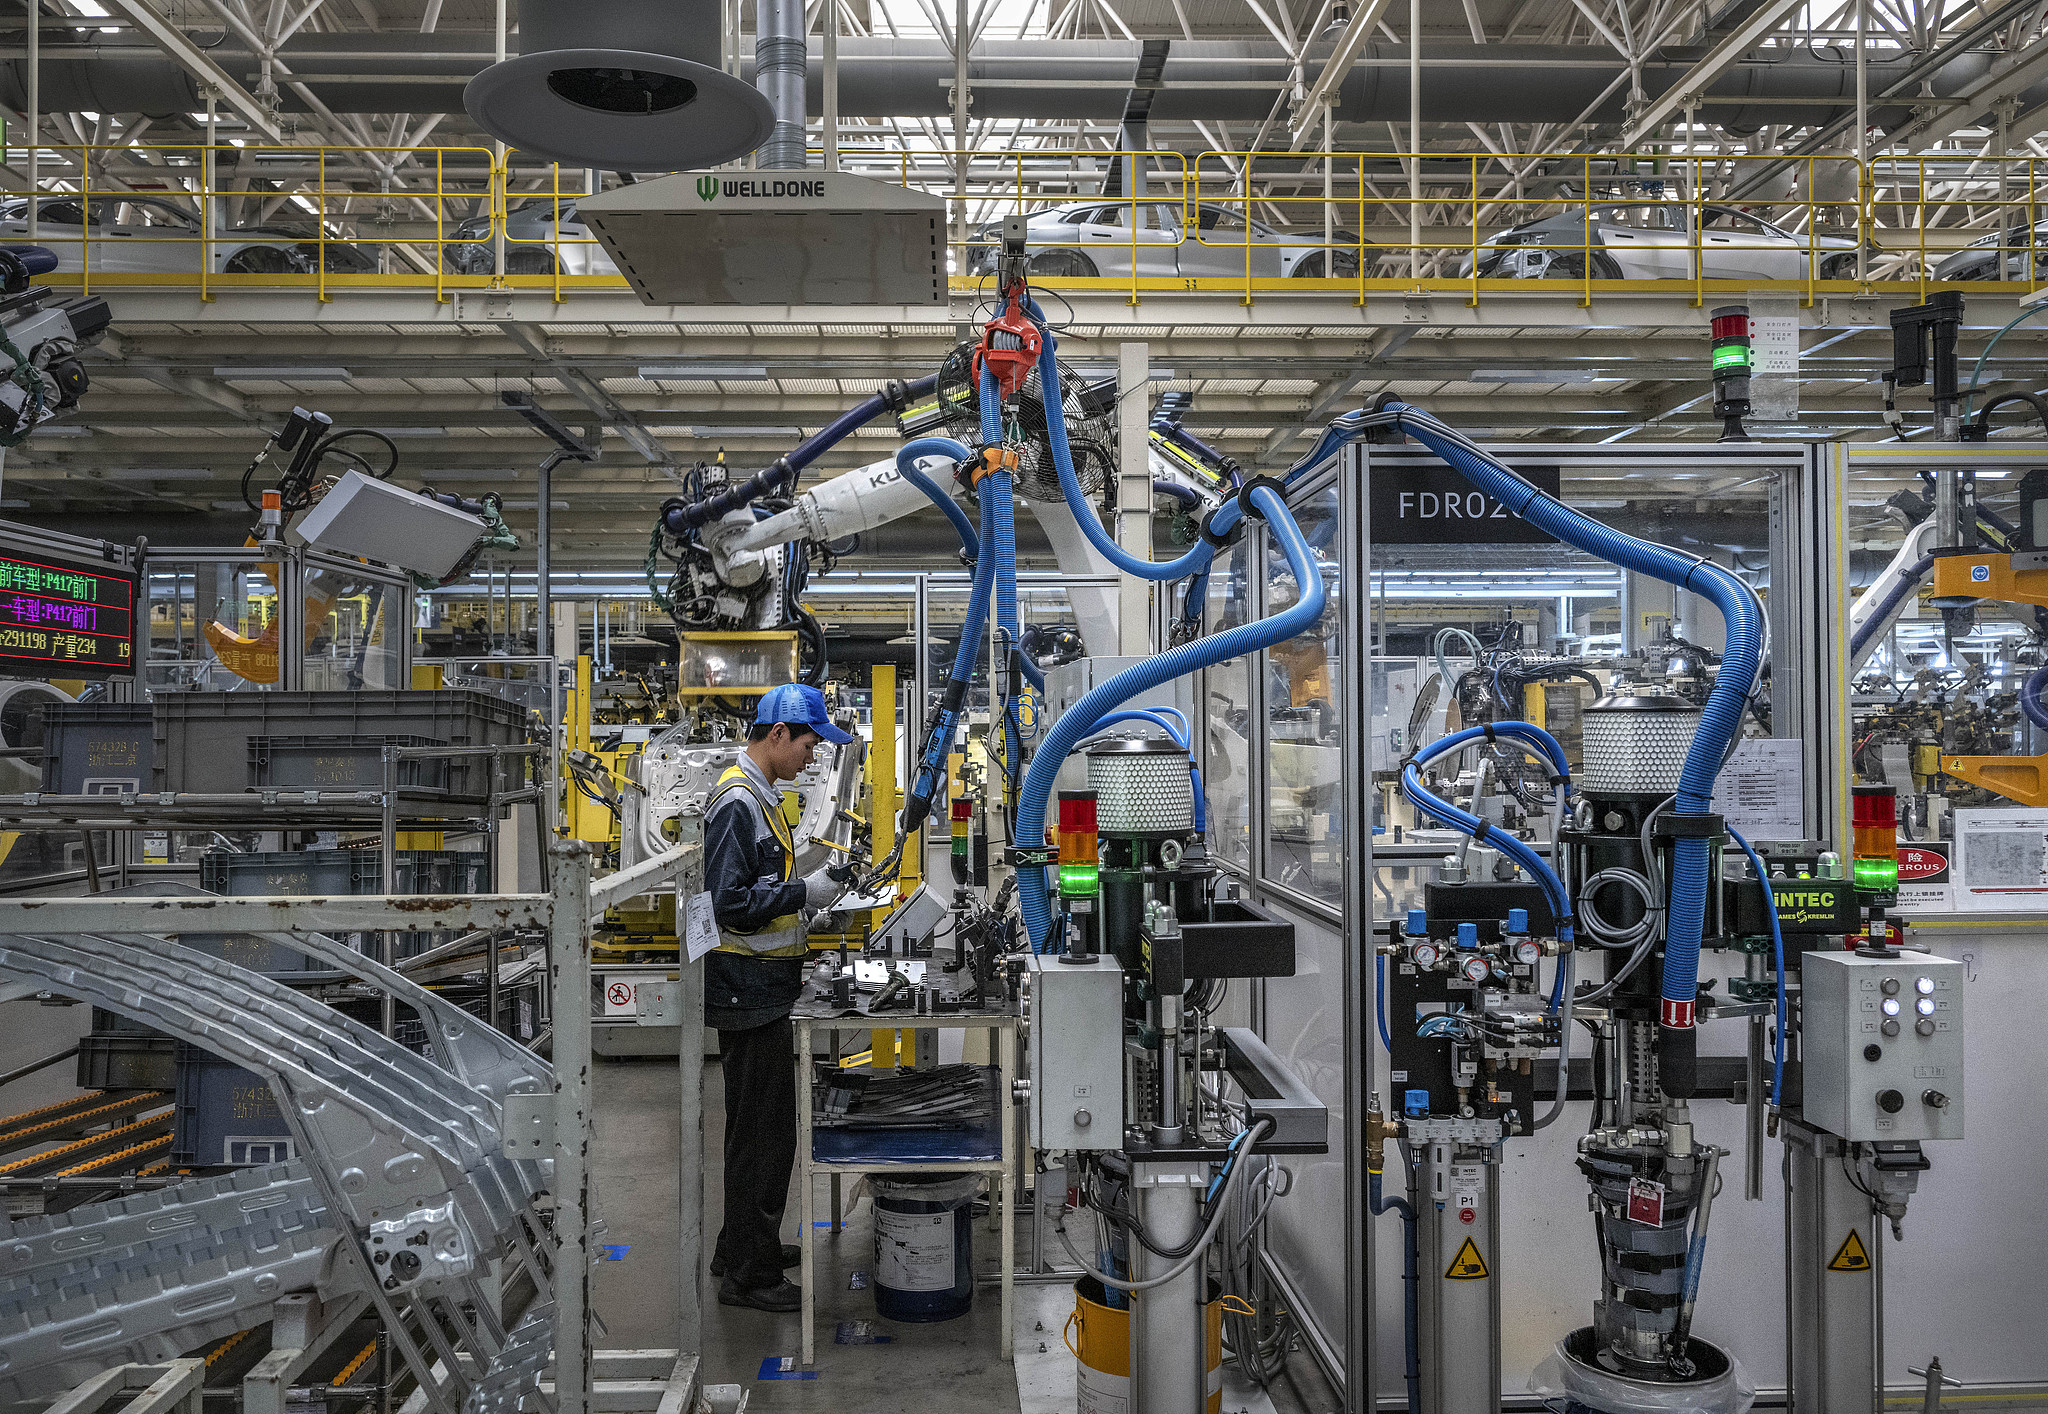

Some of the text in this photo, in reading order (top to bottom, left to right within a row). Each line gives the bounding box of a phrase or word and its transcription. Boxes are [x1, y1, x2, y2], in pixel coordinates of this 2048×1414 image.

[723, 180, 825, 198] WELLDONE
[869, 458, 932, 488] KUA
[1399, 491, 1522, 519] FDR02
[52, 633, 97, 658] 产量234
[232, 1087, 278, 1101] 57432
[1461, 1196, 1473, 1206] P1
